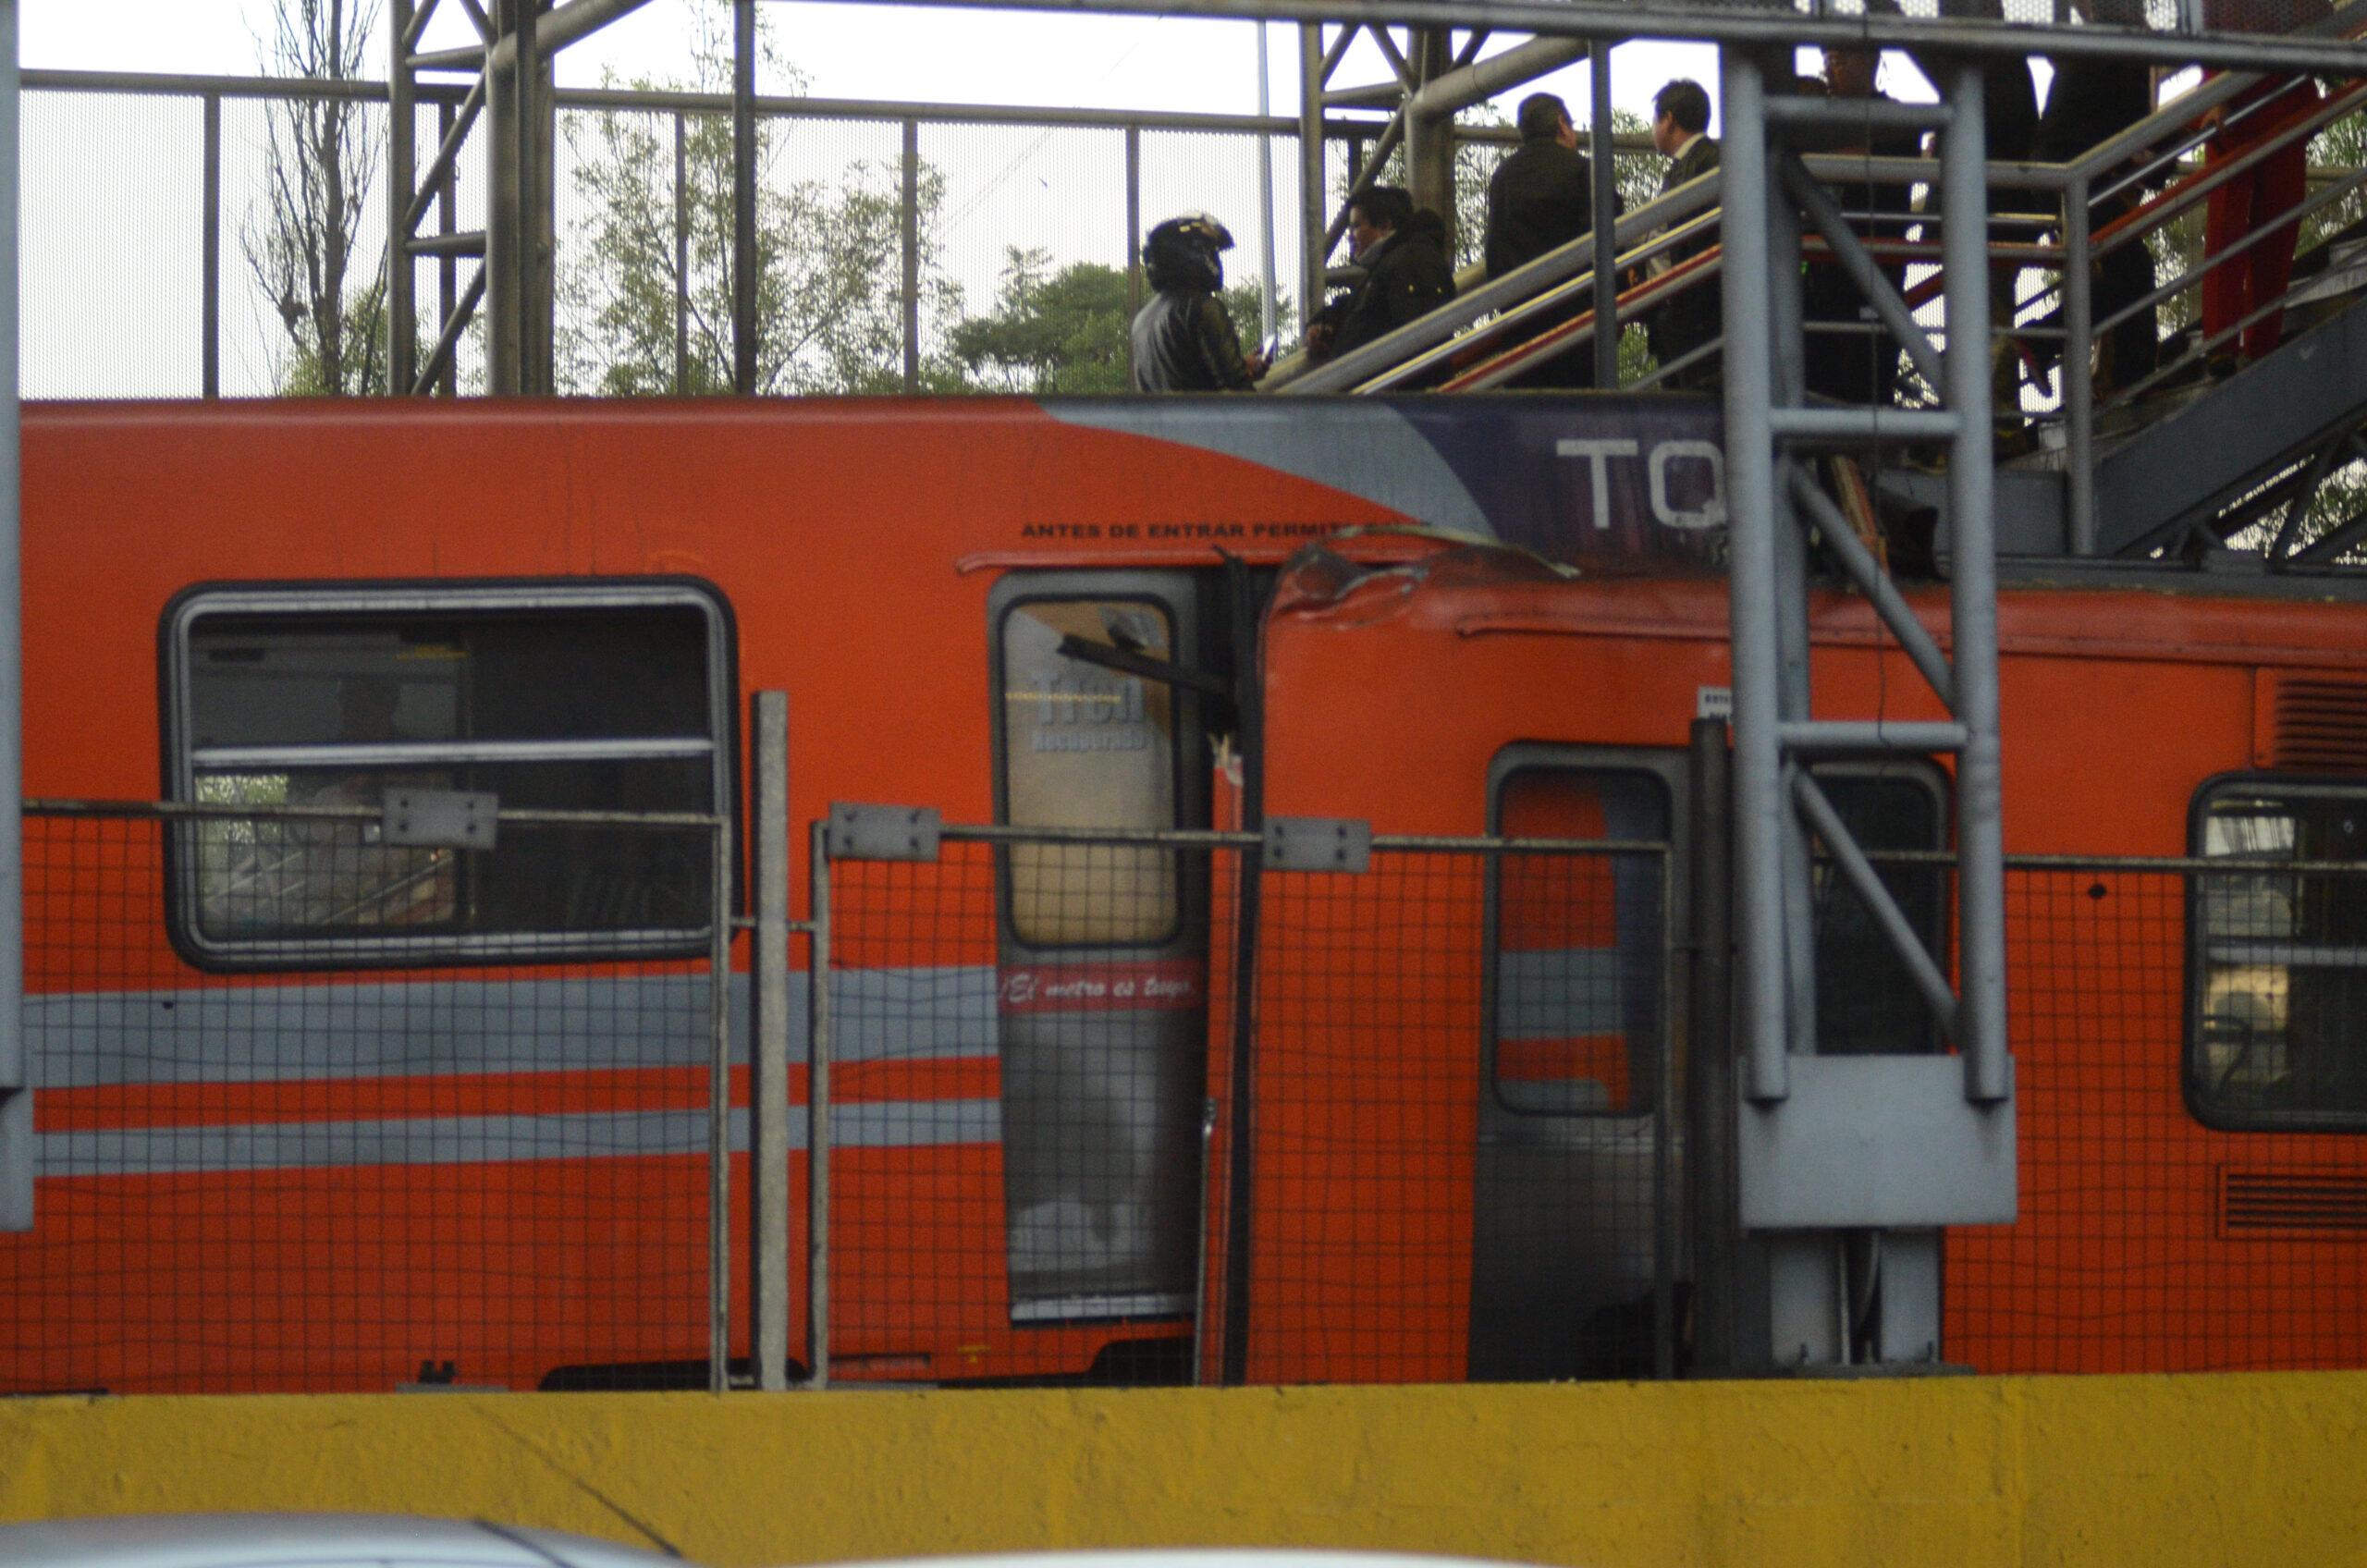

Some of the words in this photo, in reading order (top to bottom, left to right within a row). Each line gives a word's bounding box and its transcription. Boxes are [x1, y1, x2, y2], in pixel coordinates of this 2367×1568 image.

[1021, 523, 1100, 538] ANTES
[1109, 523, 1138, 538] DE
[1147, 523, 1245, 538] ENTRAR
